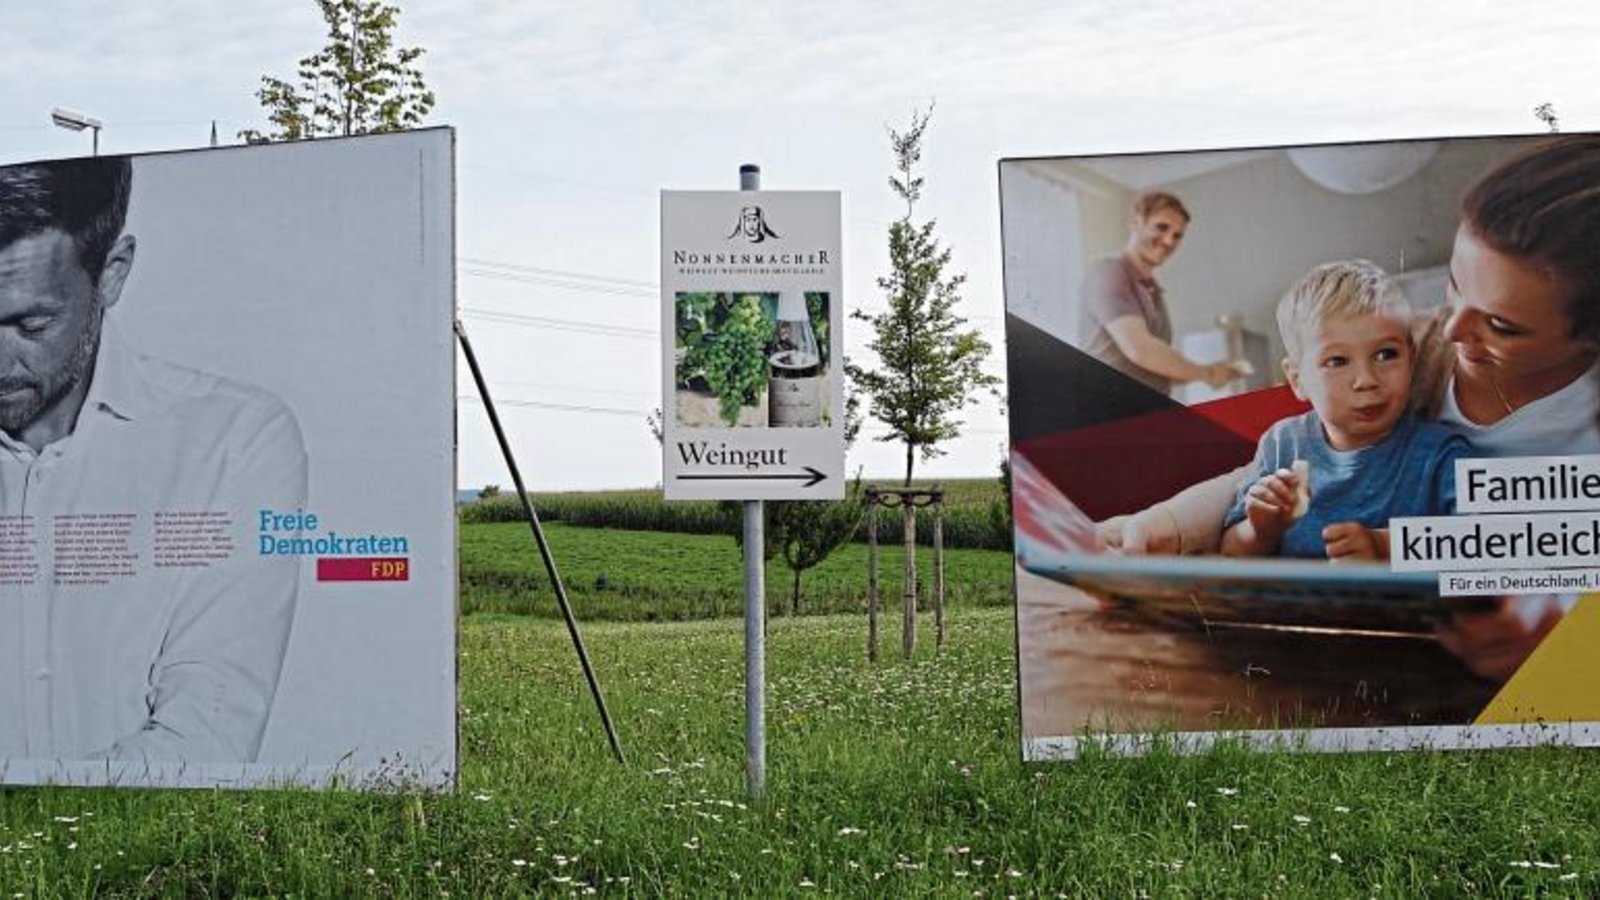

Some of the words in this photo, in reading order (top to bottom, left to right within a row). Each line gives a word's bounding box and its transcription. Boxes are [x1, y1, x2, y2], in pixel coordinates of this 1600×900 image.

[677, 442, 787, 469] Weingut
[1467, 463, 1600, 502] Familie
[259, 508, 318, 531] Freie
[259, 532, 409, 555] Demokraten
[371, 562, 405, 578] FDP
[1449, 576, 1472, 590] Für
[1474, 576, 1497, 590] ein
